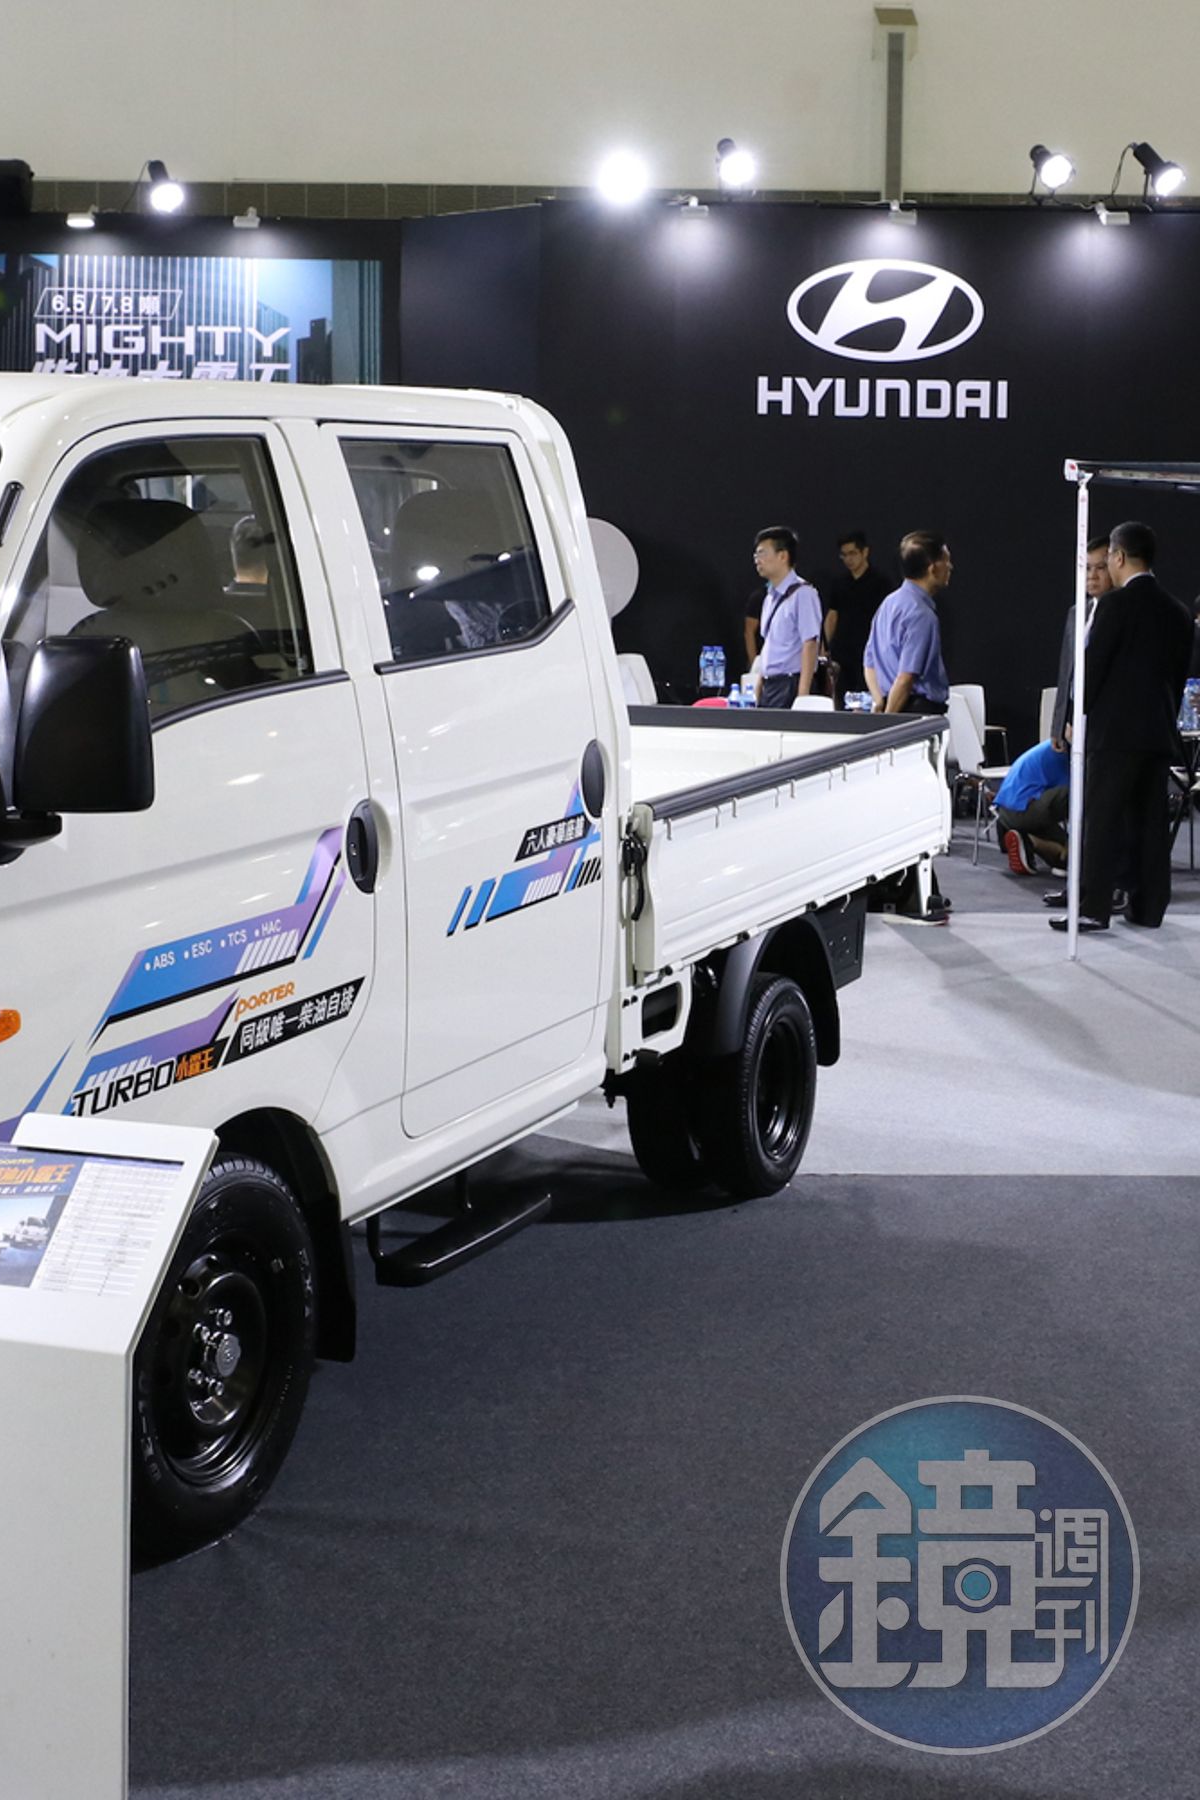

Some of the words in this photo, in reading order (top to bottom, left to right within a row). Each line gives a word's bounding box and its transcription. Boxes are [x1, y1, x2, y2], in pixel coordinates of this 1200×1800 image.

[35, 323, 292, 358] MIGHTY
[757, 376, 1009, 419] HYUNDAI
[152, 951, 176, 971] ABS
[191, 939, 213, 959] ESC
[227, 929, 248, 947] TCS
[261, 919, 283, 936] HAC
[233, 980, 296, 1022] PORTER
[239, 986, 354, 1054] 同級唯一柴油自排
[71, 1059, 176, 1117] TURBO
[175, 1046, 215, 1081] 小霸王
